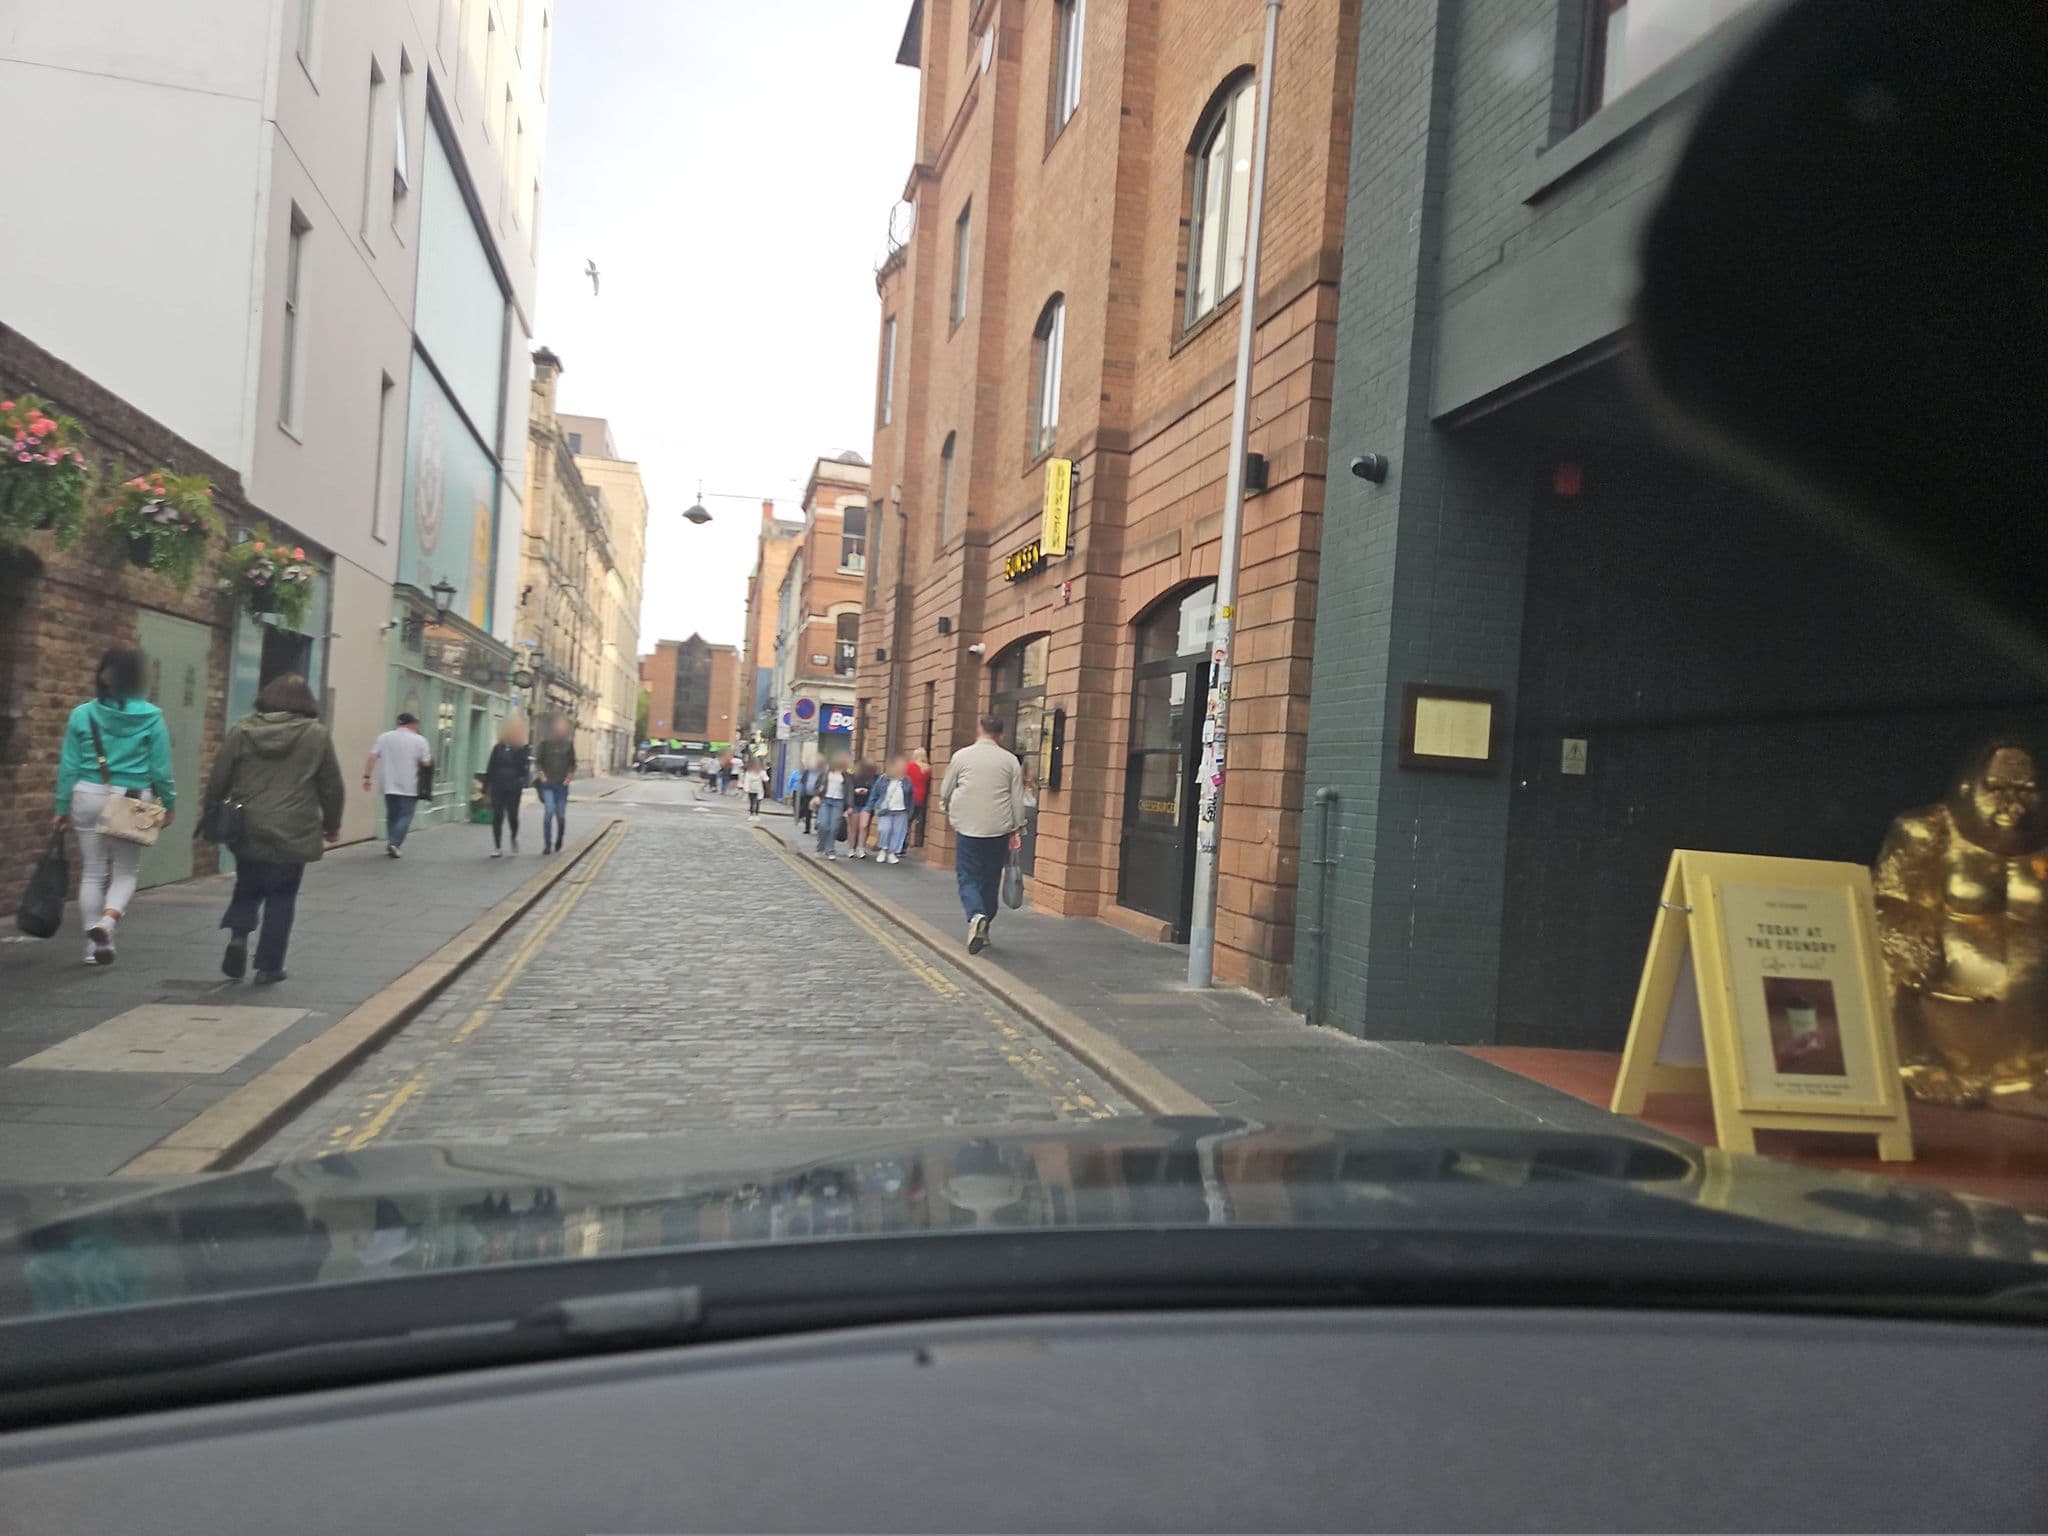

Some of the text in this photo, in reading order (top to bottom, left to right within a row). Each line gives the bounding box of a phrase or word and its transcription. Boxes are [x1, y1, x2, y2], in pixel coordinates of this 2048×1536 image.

[1757, 923, 1823, 938] TODAY AT
[1746, 937, 1837, 953] THE FOUNDRY
